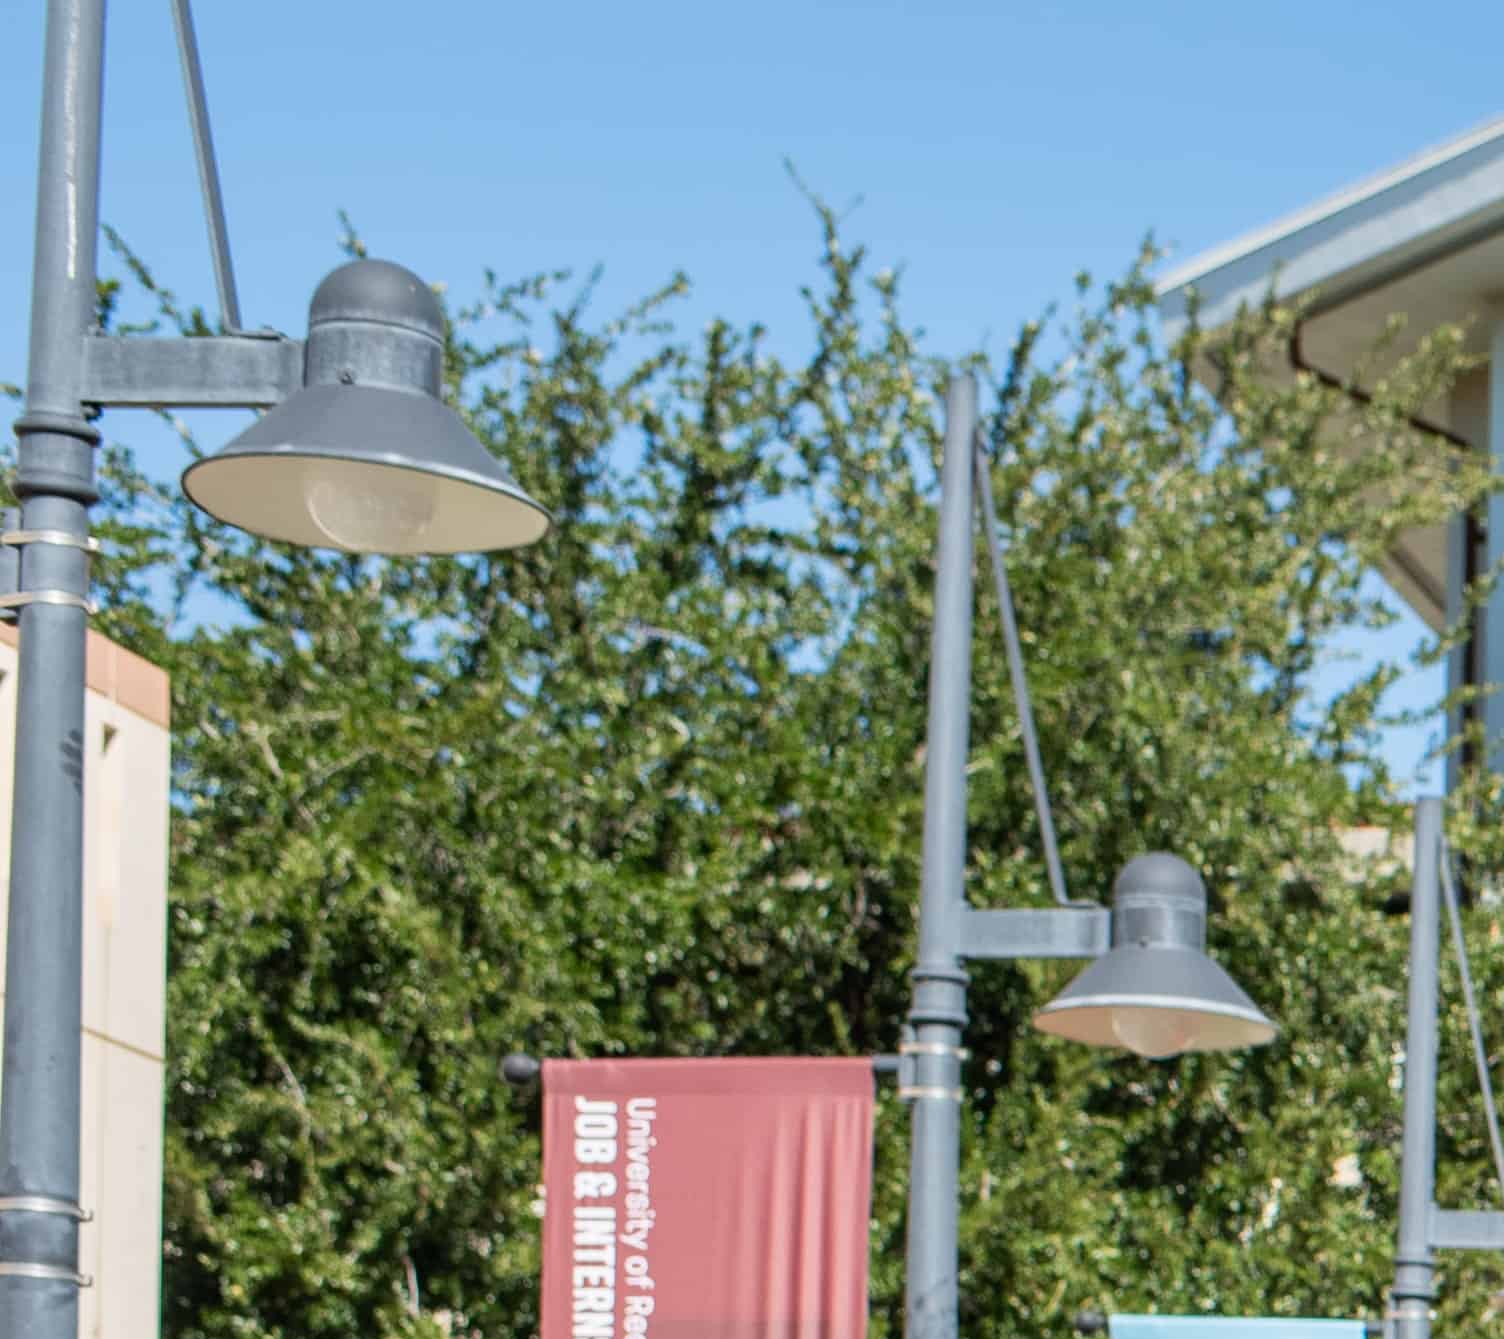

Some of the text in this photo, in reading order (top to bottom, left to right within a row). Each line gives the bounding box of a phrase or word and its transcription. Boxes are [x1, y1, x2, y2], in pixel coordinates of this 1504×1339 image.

[575, 1096, 618, 1165] JOB
[575, 1171, 617, 1199] &
[620, 1097, 657, 1251] University
[624, 1256, 655, 1288] of
